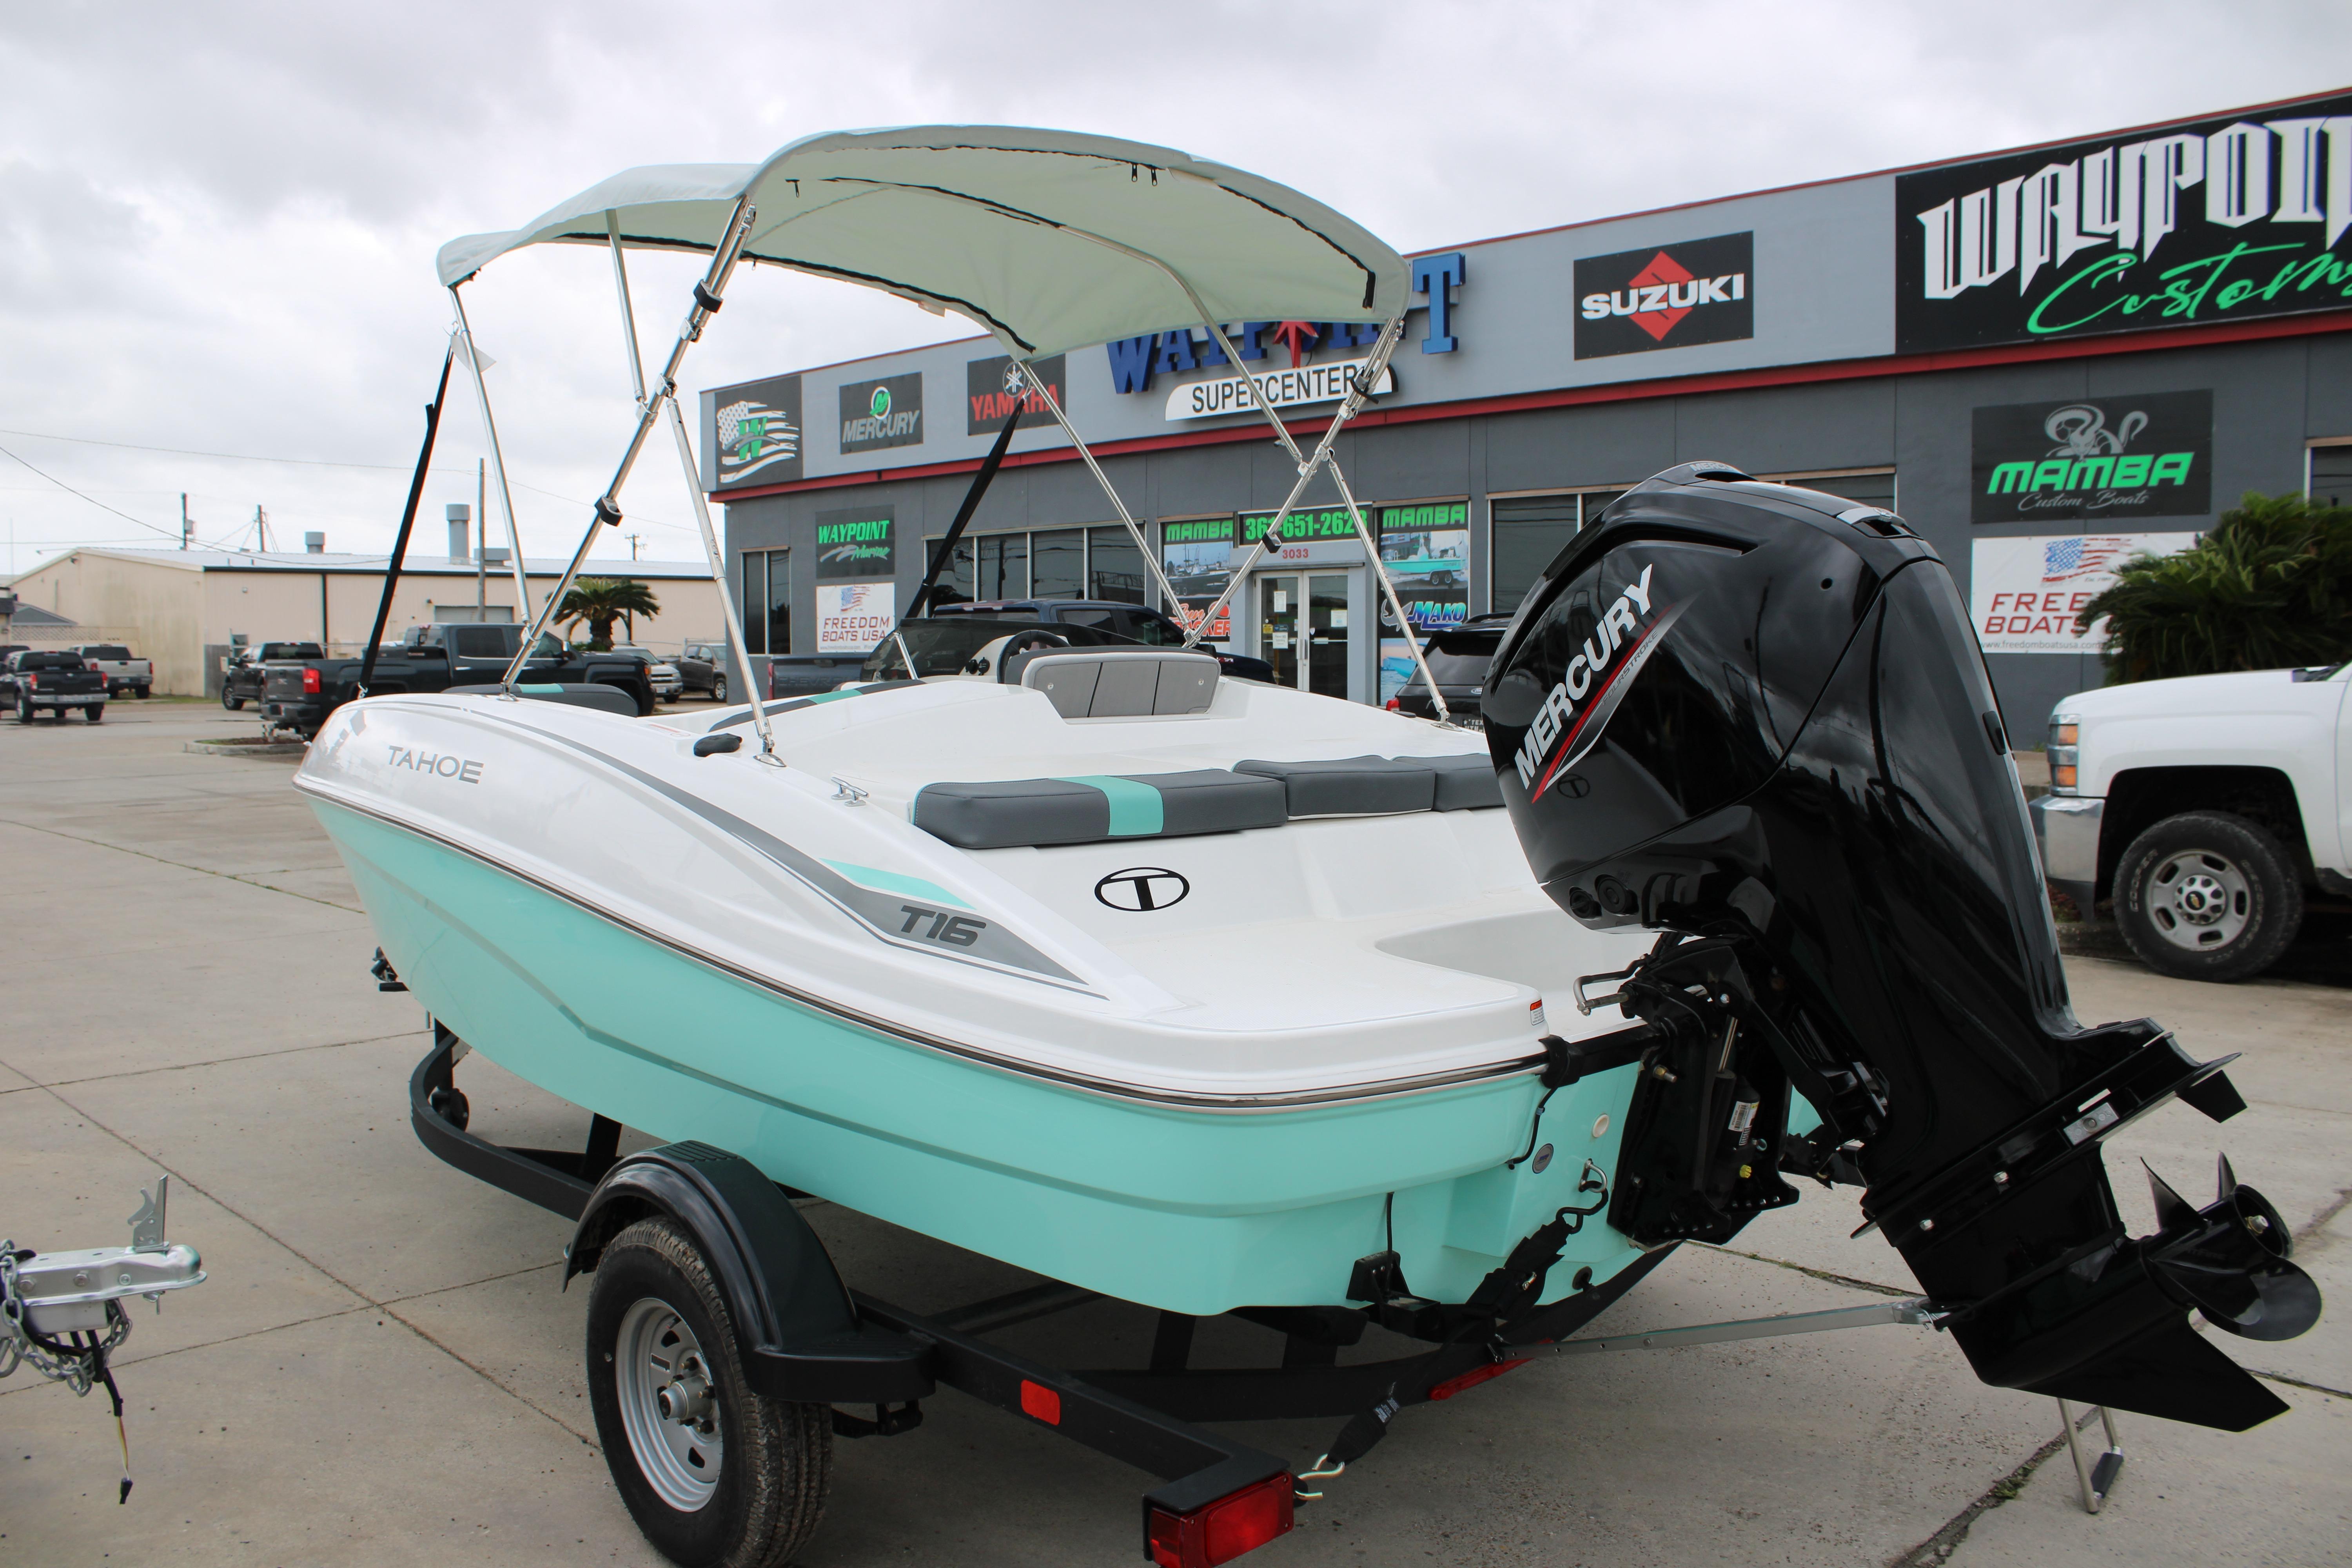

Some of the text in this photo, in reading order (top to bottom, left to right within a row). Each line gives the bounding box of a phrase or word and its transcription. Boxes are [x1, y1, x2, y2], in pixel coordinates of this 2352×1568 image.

[1582, 273, 1744, 319] SUZUKI
[842, 410, 920, 443] MERCURY
[1987, 452, 2195, 494] MAMBA
[2018, 489, 2149, 511] Custom Boats
[1383, 504, 1465, 528] MAMBA
[818, 520, 889, 544] WAYPOINT
[1167, 520, 1233, 542] MAMBA
[851, 544, 890, 561] Marine
[1282, 548, 1309, 559] 3033
[824, 616, 889, 629] FREEDOM
[1406, 601, 1466, 630] MAKO
[822, 630, 886, 642] BOATS USA
[1514, 563, 1653, 789] MERCURY
[1602, 631, 1657, 706] FOURSTROKE
[388, 745, 485, 784] TAHOE
[2130, 849, 2158, 912] COOPER
[900, 905, 986, 947] T16
